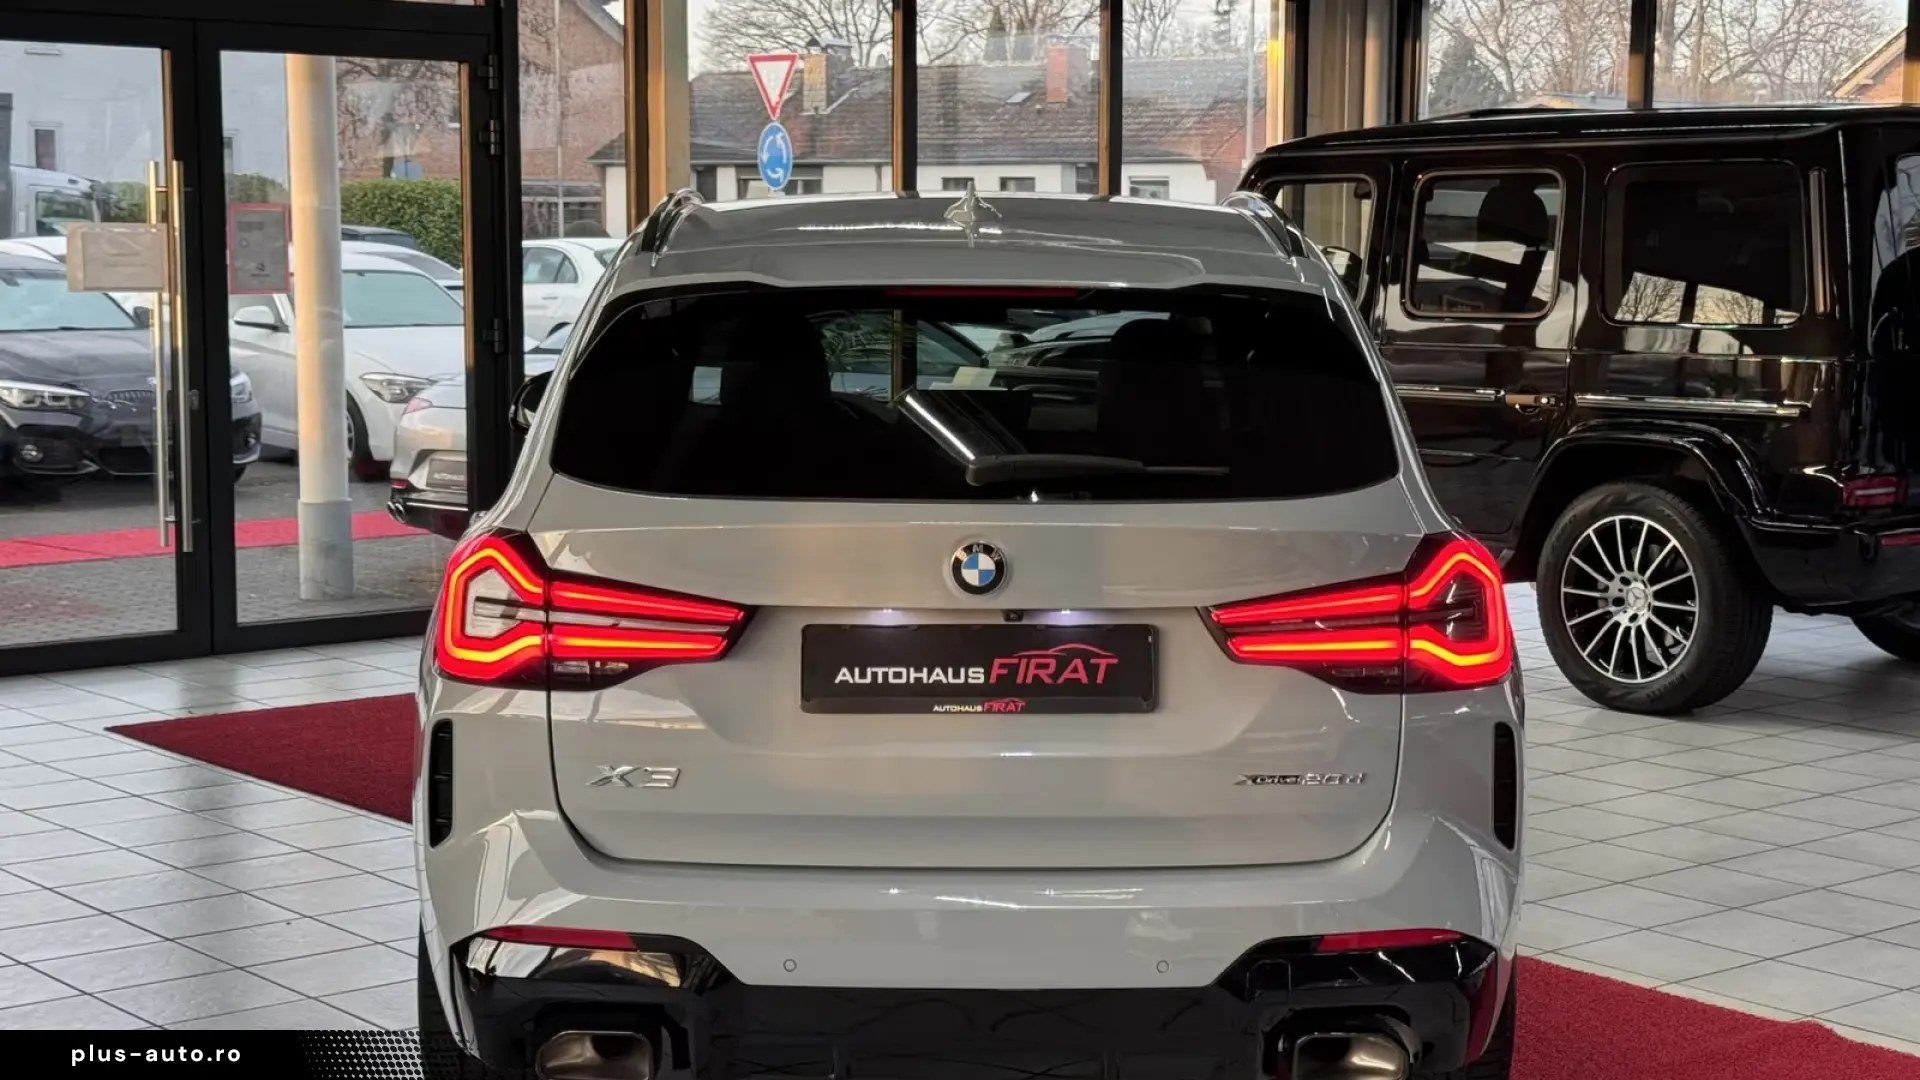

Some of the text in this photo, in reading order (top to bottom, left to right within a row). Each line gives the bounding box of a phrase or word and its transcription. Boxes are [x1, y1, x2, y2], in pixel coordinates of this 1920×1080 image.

[955, 544, 1002, 561] BMW
[835, 657, 1118, 685] AUTOHAUS FIRAT
[932, 701, 1026, 713] AUTOHAUS FIRAT
[586, 765, 681, 788] X3
